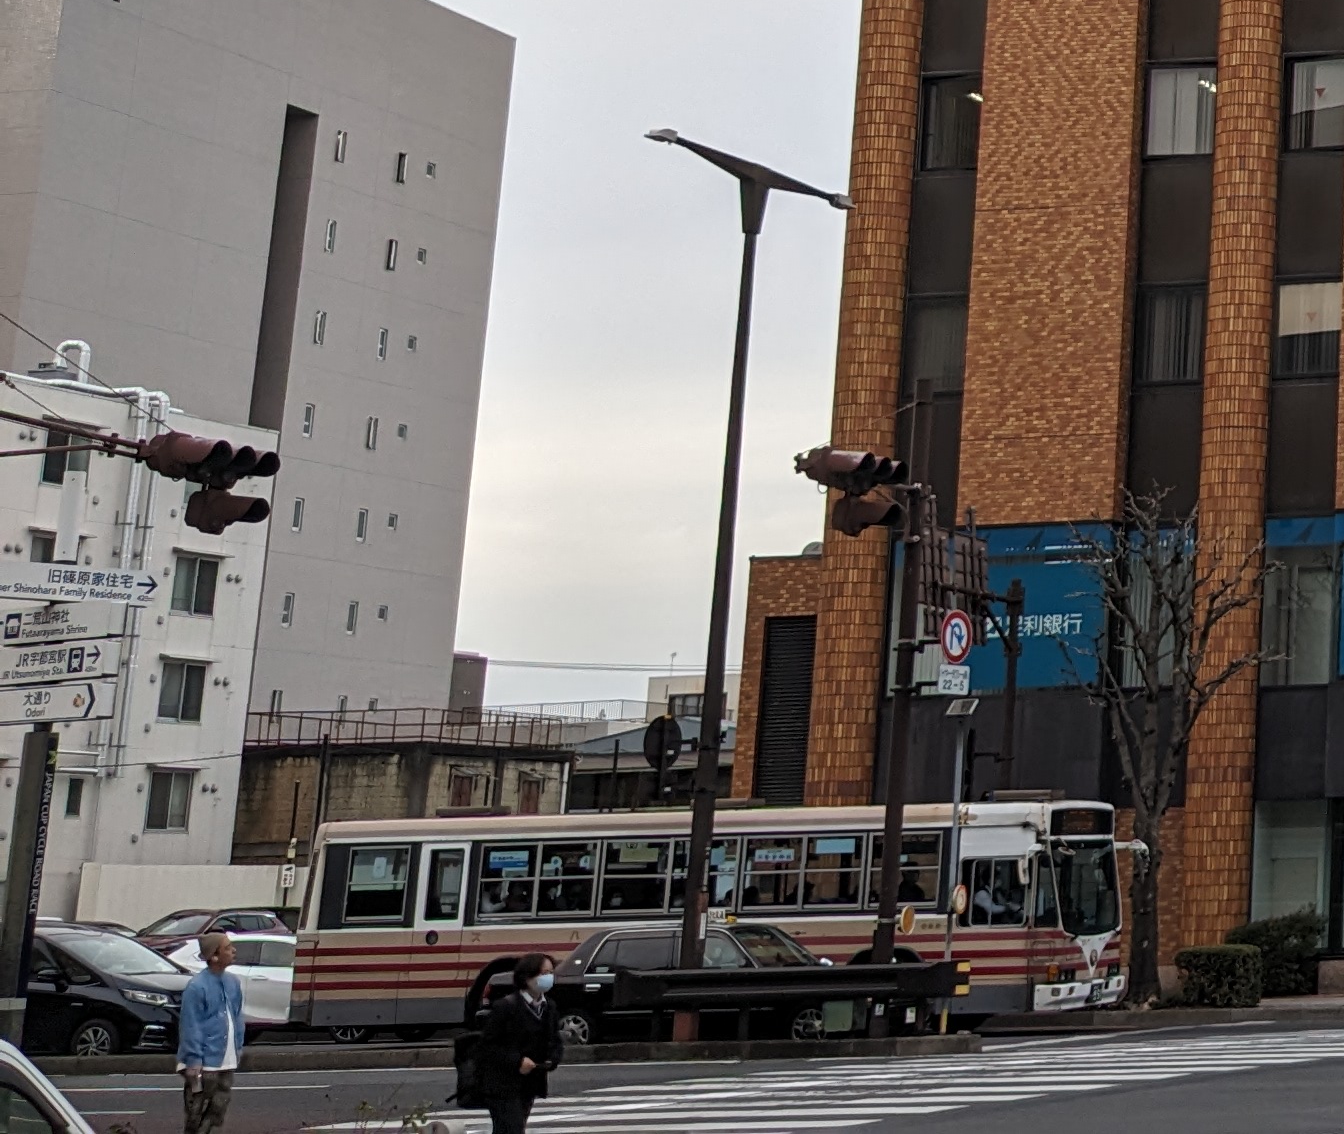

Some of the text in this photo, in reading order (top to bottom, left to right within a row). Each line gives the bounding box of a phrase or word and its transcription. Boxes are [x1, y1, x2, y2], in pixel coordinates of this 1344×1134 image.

[48, 568, 134, 588] 旧篠原家住宅
[14, 583, 57, 595] Shinohara
[59, 586, 87, 599] Family
[90, 589, 132, 601] Residence
[16, 649, 67, 667] JR宇都宮駅
[23, 691, 51, 706] 大通り
[25, 708, 45, 717] Odori
[29, 771, 54, 915] JAPAN CUP CYCLE ROAD RACE
